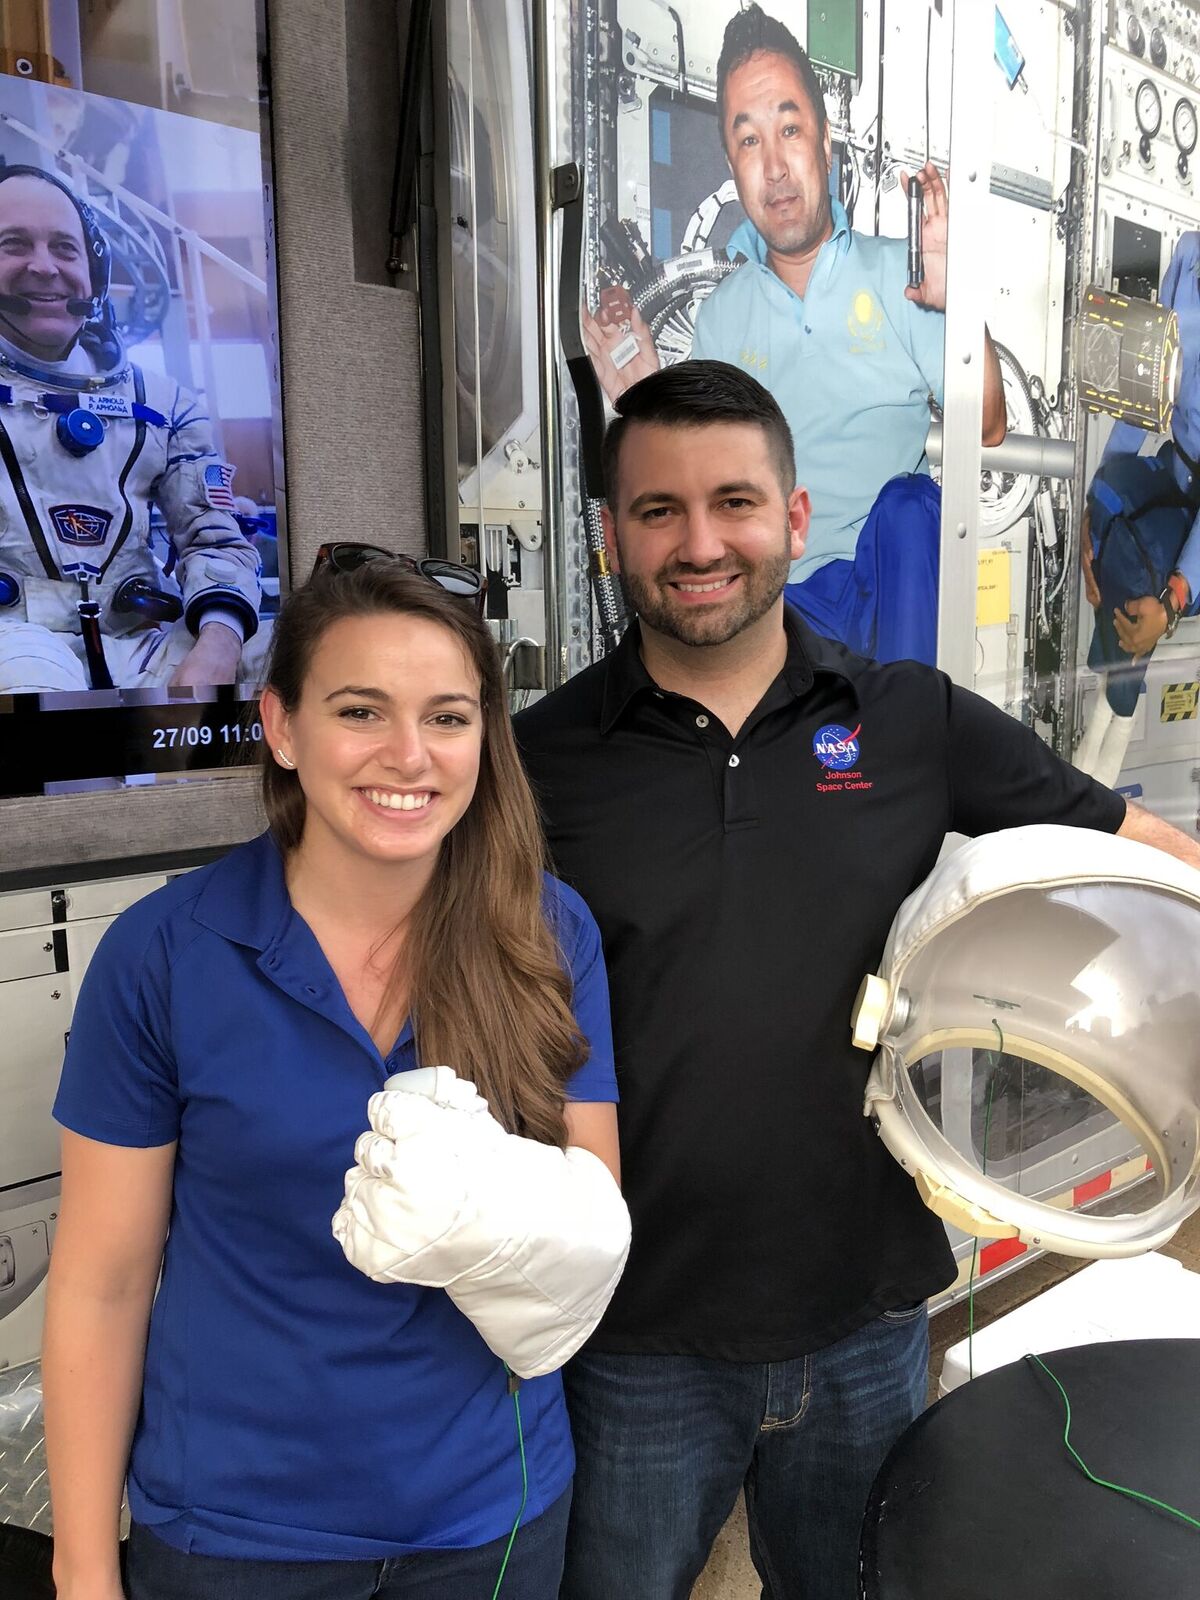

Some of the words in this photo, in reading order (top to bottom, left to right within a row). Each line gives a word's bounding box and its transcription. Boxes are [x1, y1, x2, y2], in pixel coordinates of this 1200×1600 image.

[152, 726, 212, 748] 27/09
[220, 723, 262, 743] 11:0
[816, 741, 857, 754] NASA
[825, 771, 862, 780] Johnson
[816, 782, 843, 793] Space
[844, 781, 873, 790] Center
